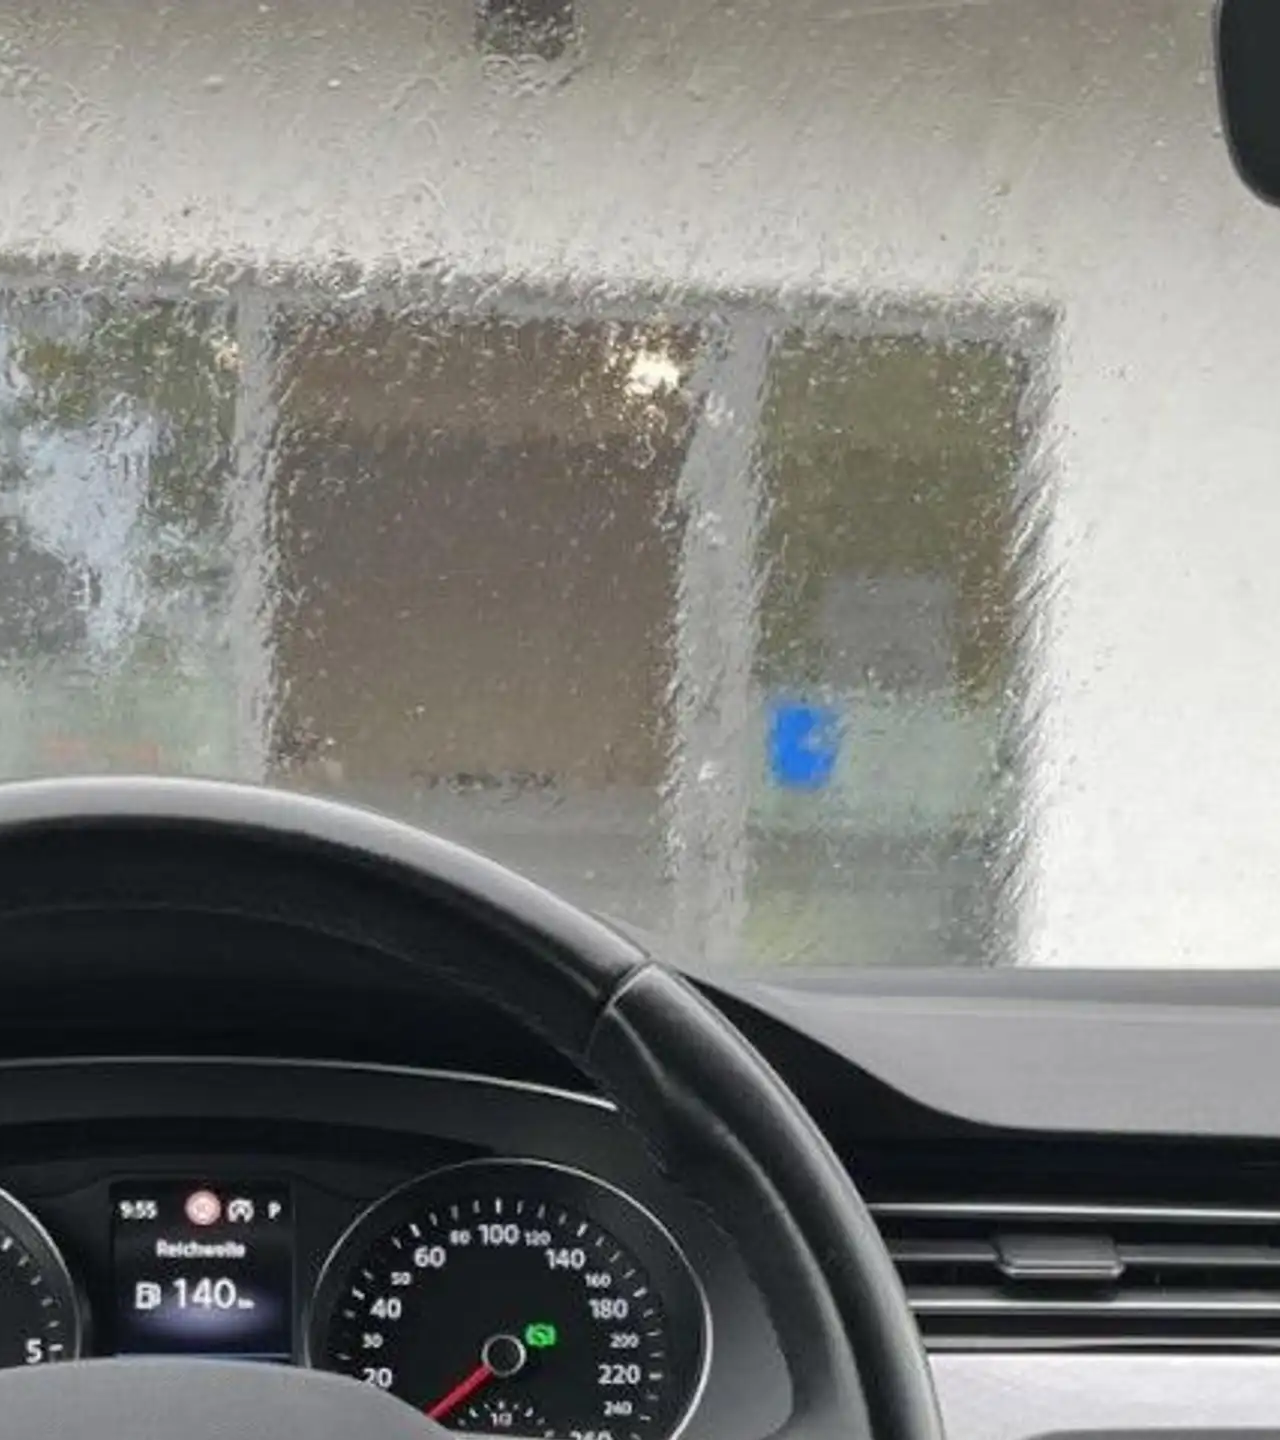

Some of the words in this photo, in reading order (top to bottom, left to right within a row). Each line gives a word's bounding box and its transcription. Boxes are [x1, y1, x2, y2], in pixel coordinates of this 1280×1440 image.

[120, 1201, 157, 1218] 9:55
[450, 1230, 470, 1244] 80
[478, 1224, 520, 1245] 100
[524, 1230, 551, 1246] 120
[157, 1240, 245, 1257] Reichweite
[415, 1246, 445, 1267] 60
[546, 1249, 585, 1269] 140
[392, 1272, 411, 1285] 50
[585, 1273, 611, 1287] 160
[173, 1277, 236, 1309] 140
[371, 1298, 401, 1318] 40
[589, 1299, 628, 1319] 180
[363, 1333, 383, 1348] 30
[611, 1333, 639, 1348] 200
[26, 1338, 42, 1362] 5
[363, 1367, 393, 1387] 20
[599, 1364, 640, 1384] 220
[604, 1401, 632, 1415] 240
